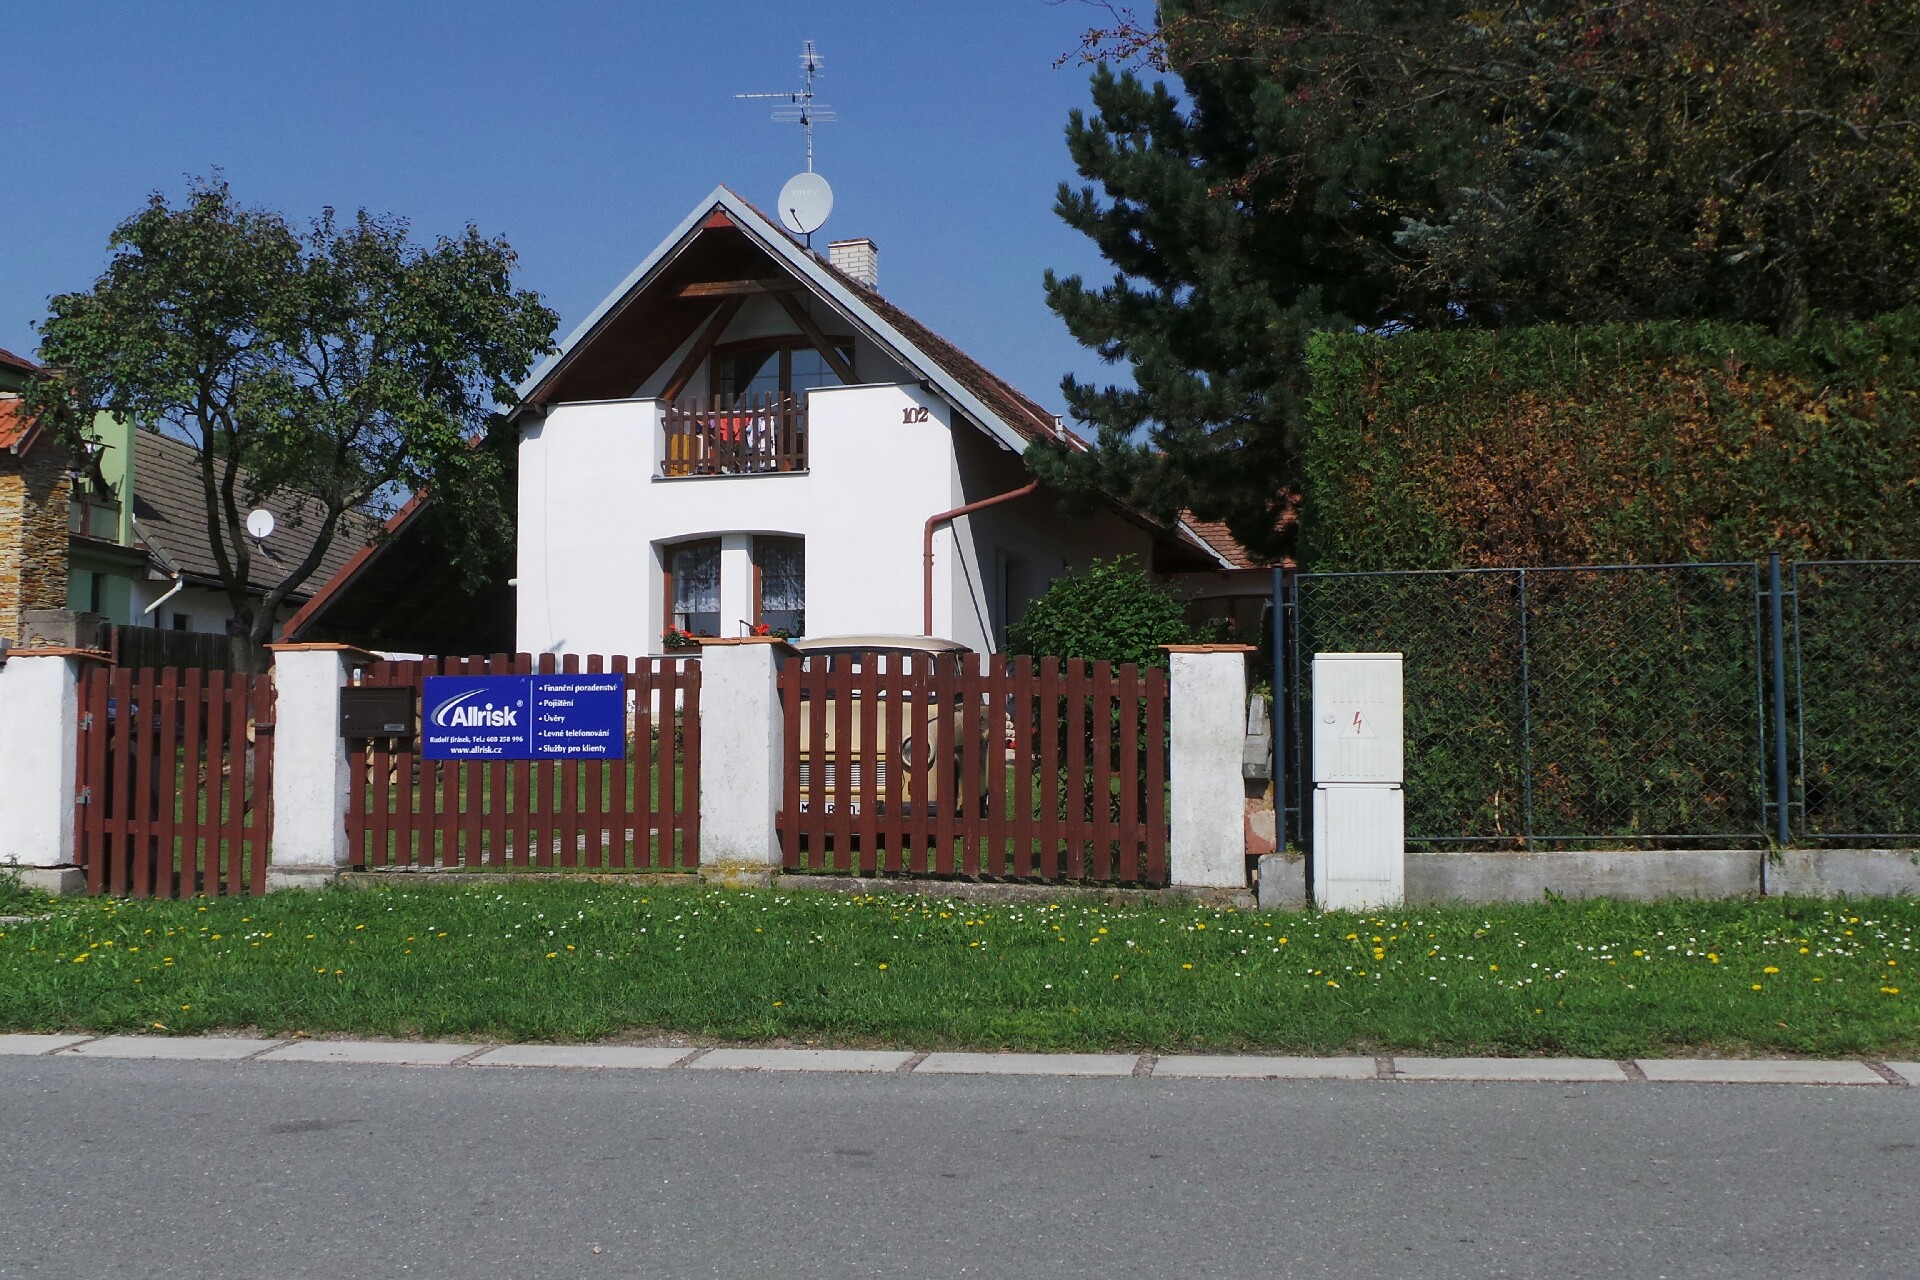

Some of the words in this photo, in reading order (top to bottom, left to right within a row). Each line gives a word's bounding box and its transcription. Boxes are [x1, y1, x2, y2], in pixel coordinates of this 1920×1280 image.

[902, 406, 929, 424] 102
[543, 684, 574, 692] Finanční
[574, 683, 617, 693] poradenství
[543, 699, 574, 708] Pojištění
[450, 702, 518, 727] Allrisk
[543, 712, 566, 724] Úvěry
[543, 729, 564, 737] Levné
[565, 728, 610, 737] telefonování
[450, 745, 503, 754] www.allrisk.cz
[543, 744, 566, 754] Služby
[567, 746, 581, 754] pro
[582, 744, 606, 754] klienty
